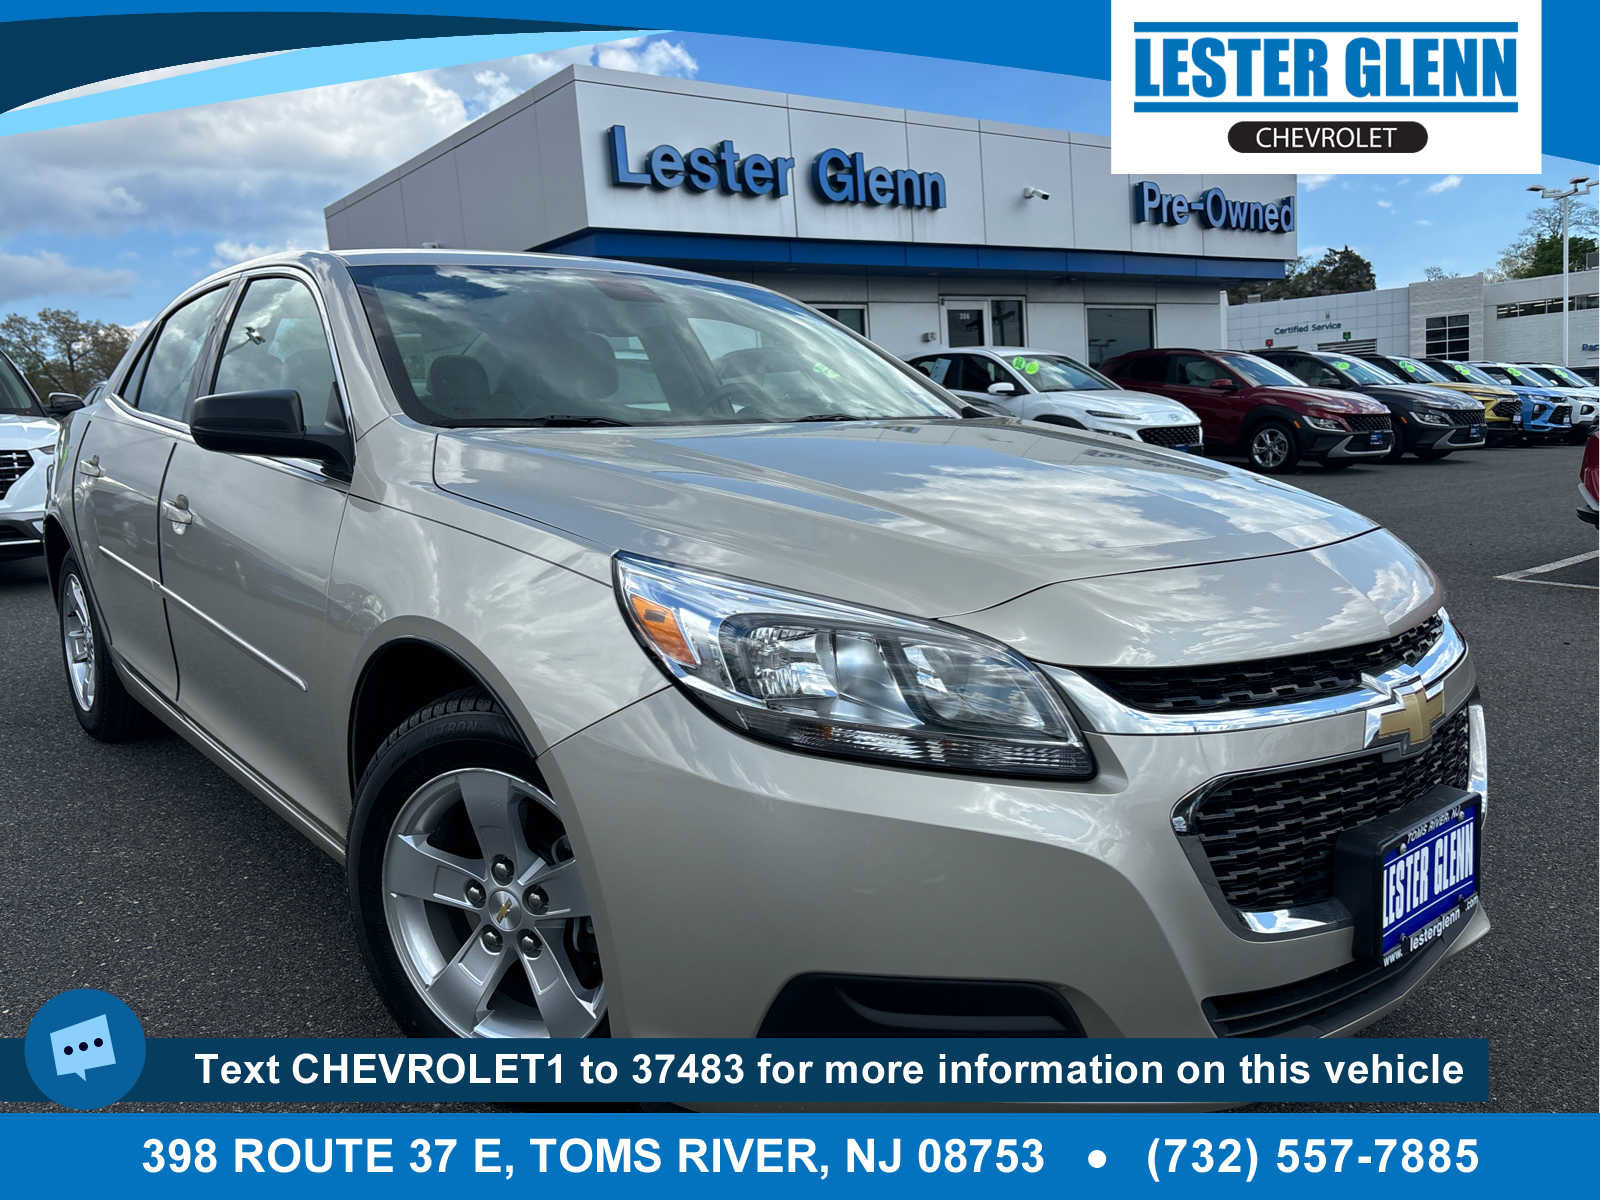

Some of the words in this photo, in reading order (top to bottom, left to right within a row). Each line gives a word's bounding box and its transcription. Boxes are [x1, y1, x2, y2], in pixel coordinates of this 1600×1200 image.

[607, 125, 795, 198] Lester
[811, 148, 947, 210] Glenn
[1135, 180, 1295, 234] Pre-Owned
[1274, 325, 1309, 335] Certified
[1312, 322, 1342, 332] Service
[1382, 846, 1430, 930] LESTER
[1433, 821, 1474, 896] GLENN
[1409, 907, 1460, 952] lesterglenn
